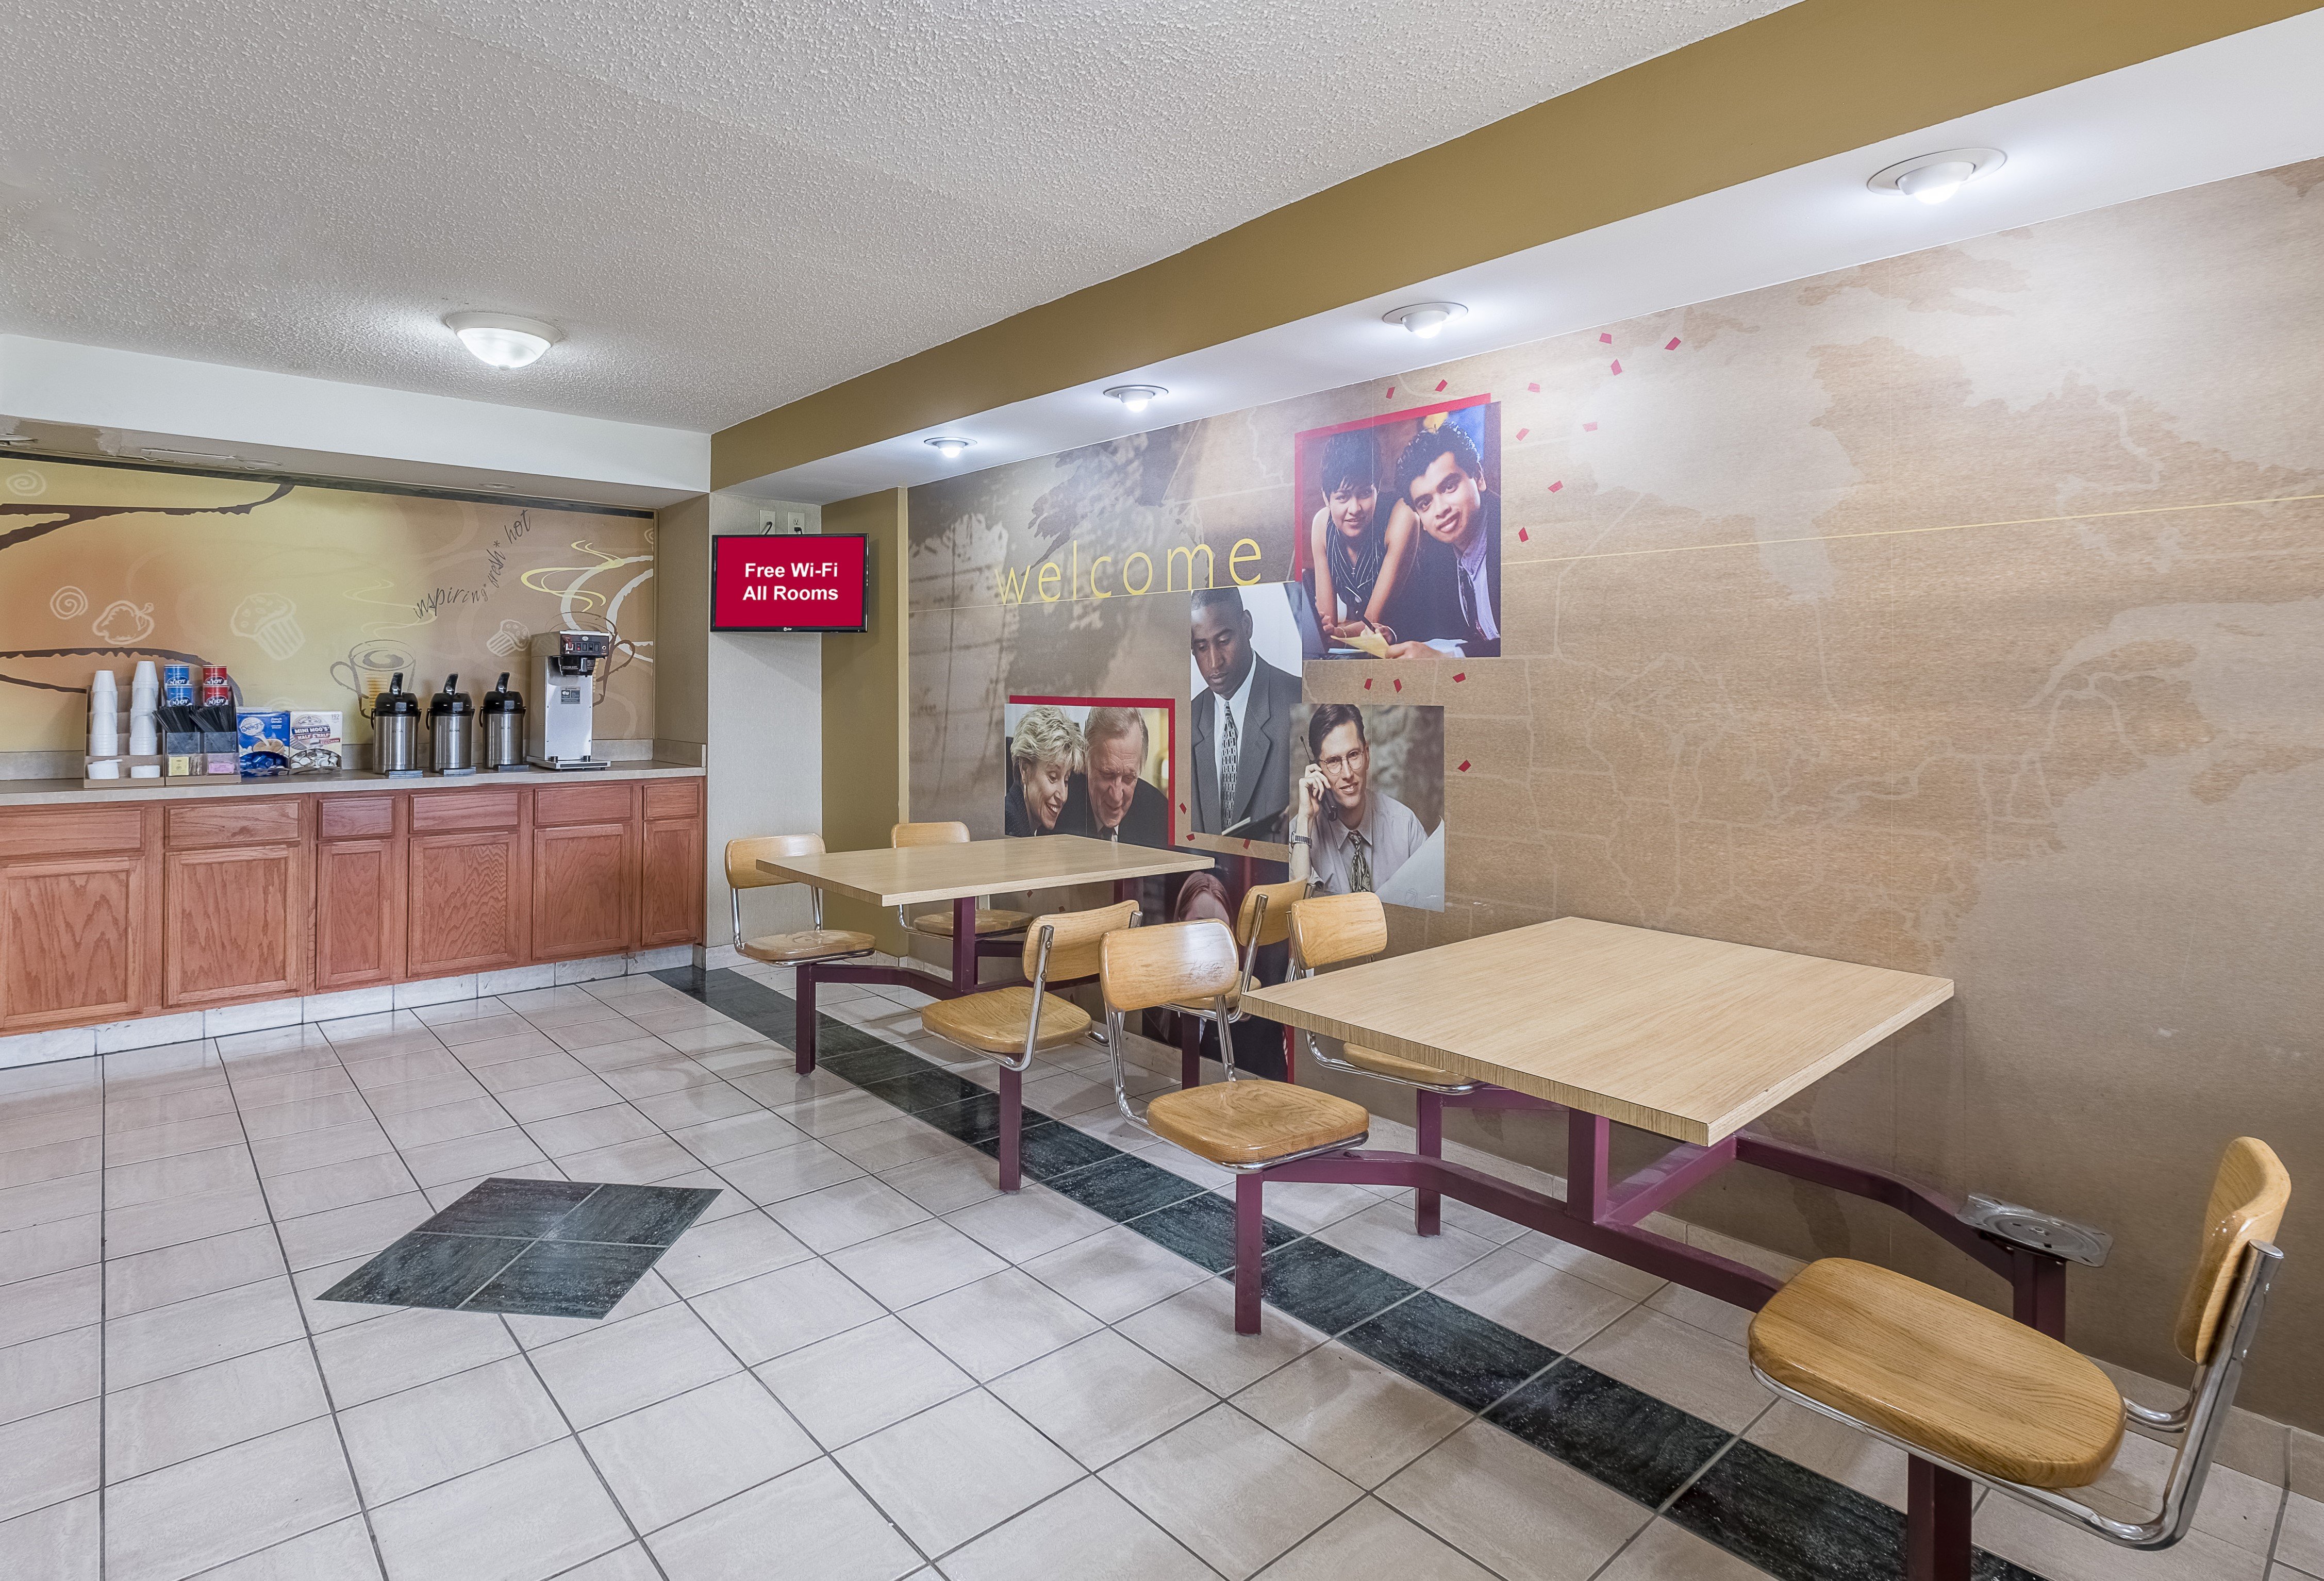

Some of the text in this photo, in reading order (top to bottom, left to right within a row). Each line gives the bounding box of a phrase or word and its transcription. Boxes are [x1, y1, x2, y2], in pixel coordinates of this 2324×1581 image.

[504, 509, 531, 544] hot
[745, 562, 838, 577] Free Wi-Fi
[994, 538, 1261, 605] welcome
[742, 586, 839, 601] All Rooms
